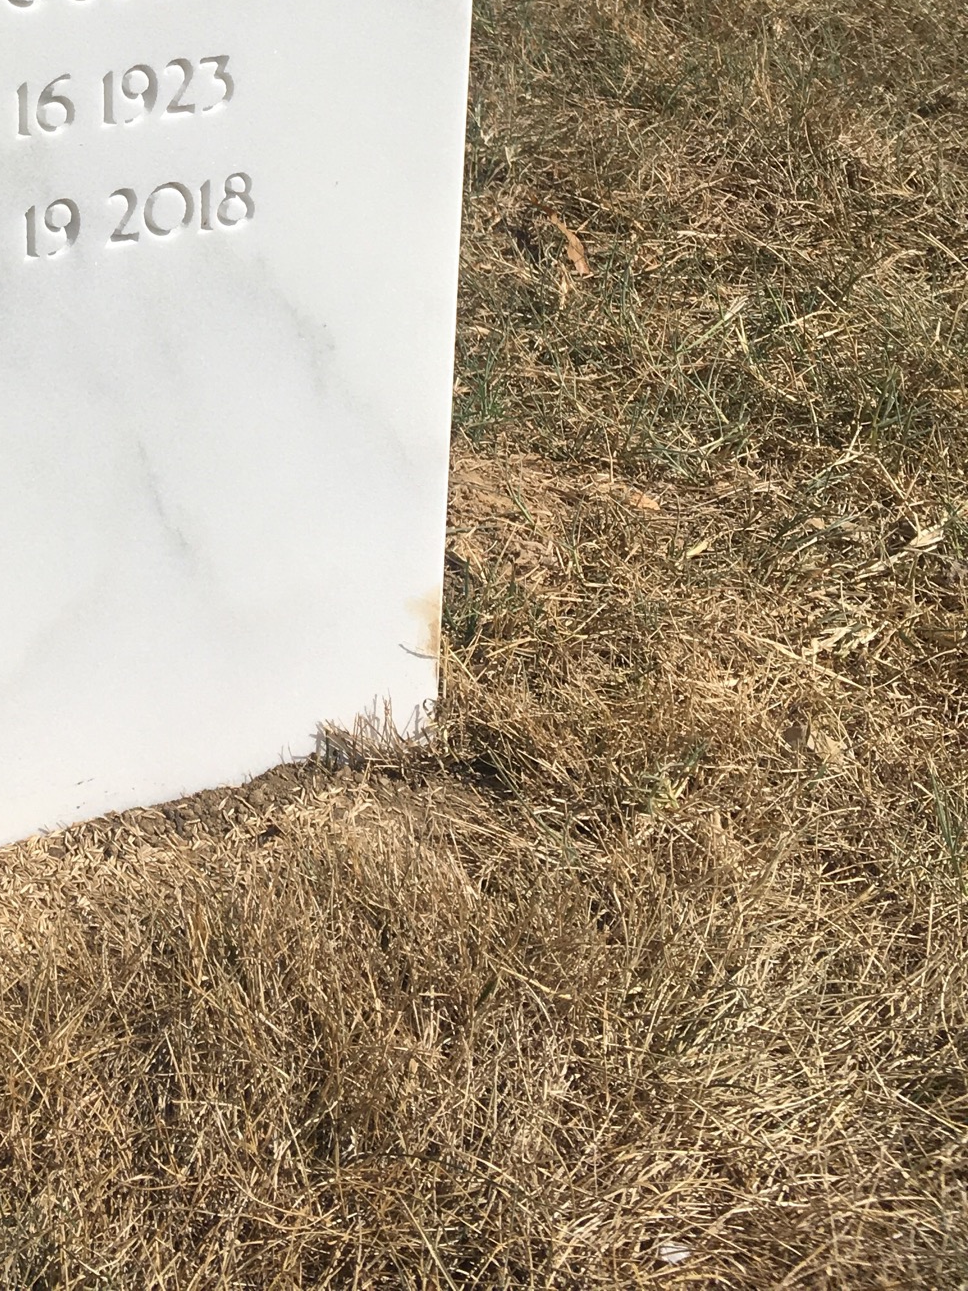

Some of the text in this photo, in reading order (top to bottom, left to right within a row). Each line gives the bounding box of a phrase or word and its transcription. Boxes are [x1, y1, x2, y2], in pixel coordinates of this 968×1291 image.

[16, 73, 76, 137] 16
[102, 55, 234, 125] 1923
[25, 198, 81, 258] 19
[108, 172, 255, 242] 2018
